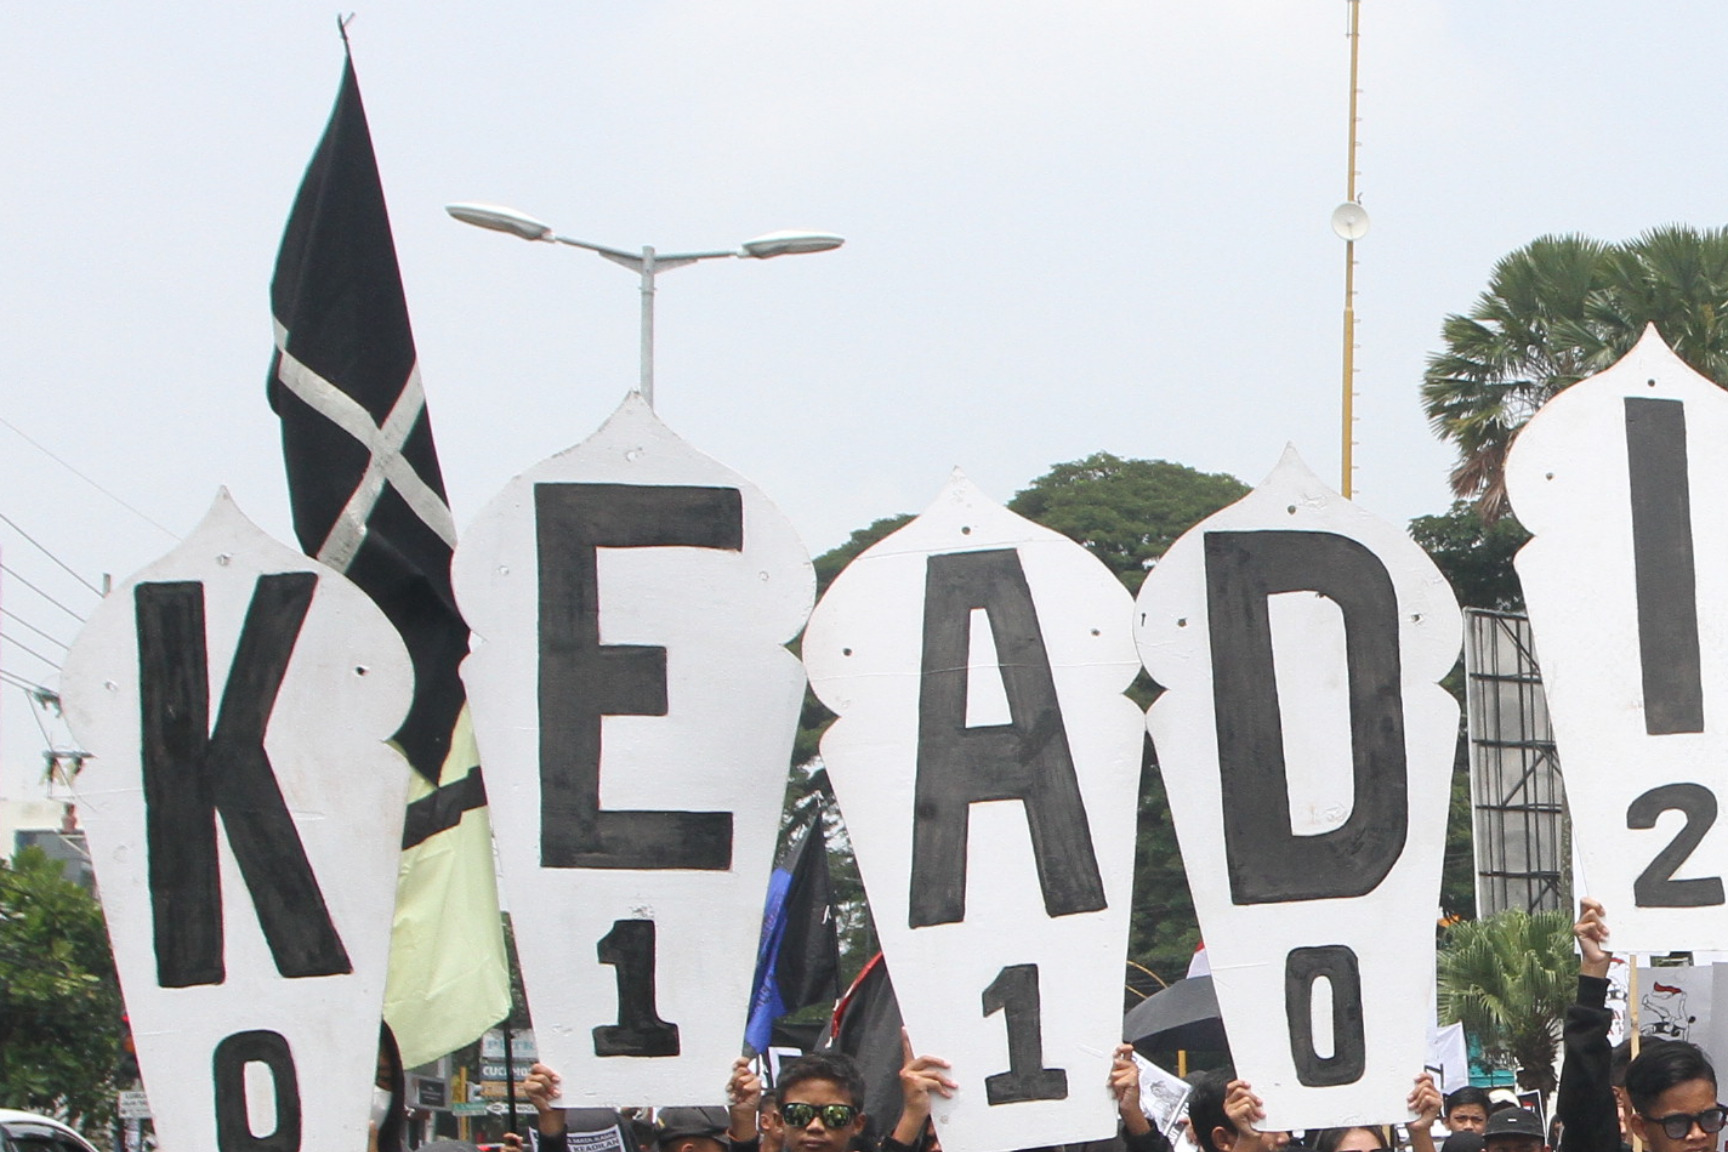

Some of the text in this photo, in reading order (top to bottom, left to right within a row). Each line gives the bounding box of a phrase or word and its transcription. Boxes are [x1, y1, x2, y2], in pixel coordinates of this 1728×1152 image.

[134, 571, 353, 987] K
[534, 482, 743, 871] E
[908, 546, 1108, 929] A
[1203, 528, 1409, 905] D
[1625, 782, 1725, 908] 2
[593, 919, 681, 1058] 1
[981, 962, 1069, 1107] 1
